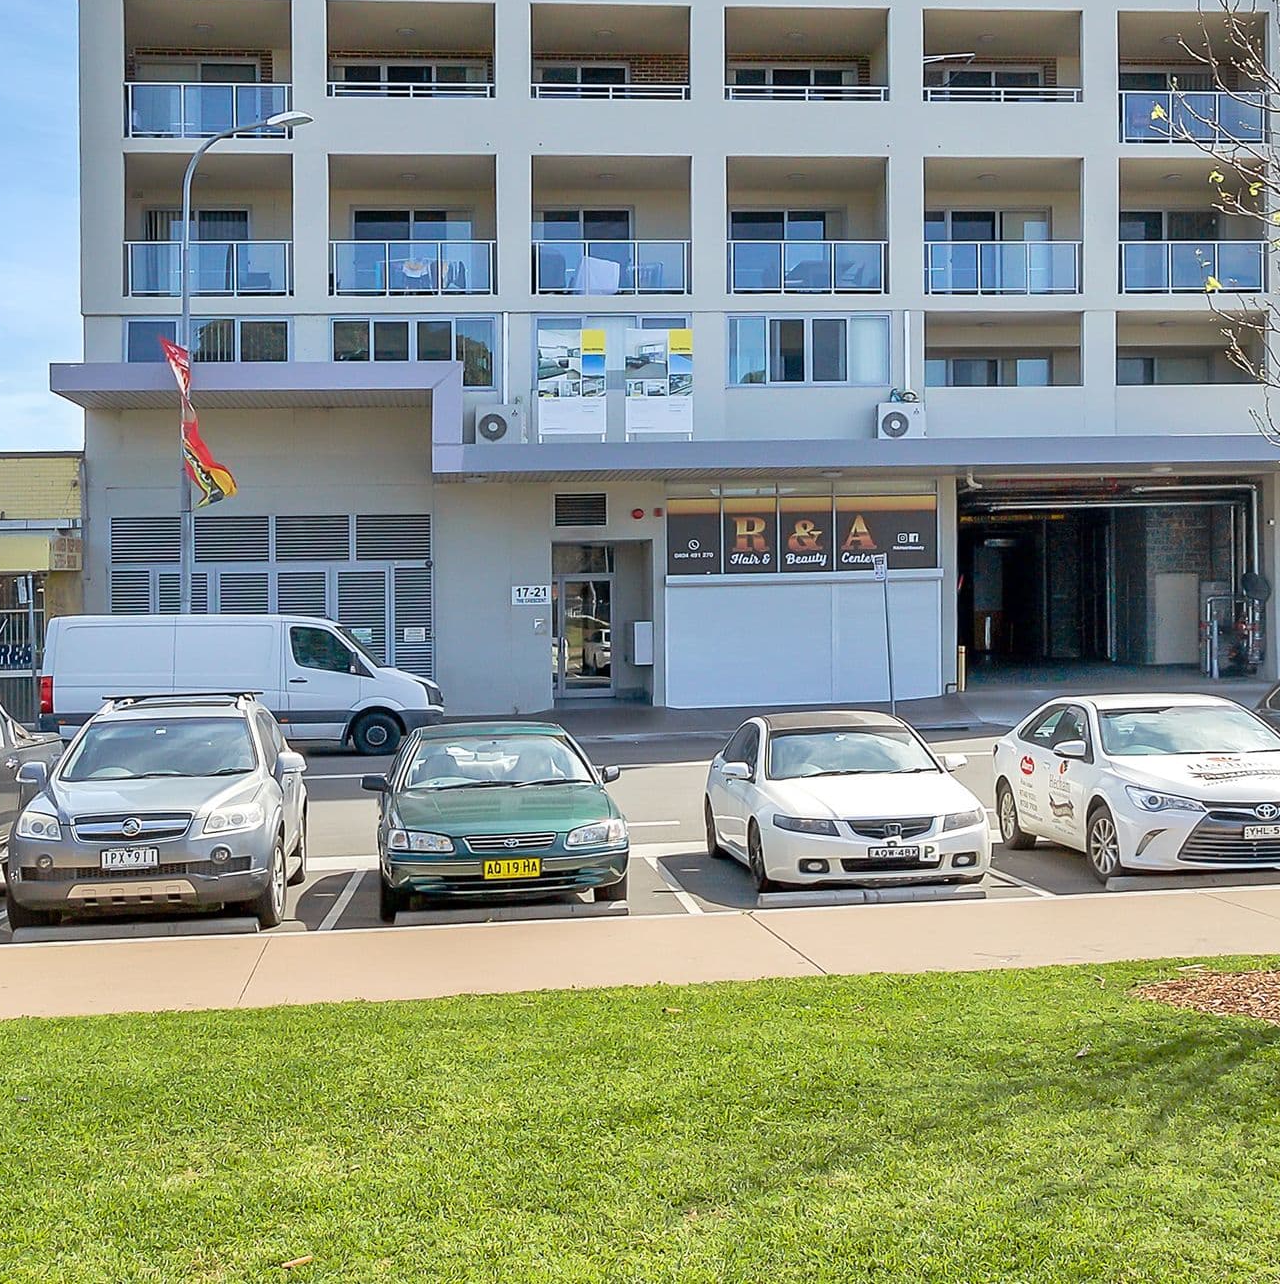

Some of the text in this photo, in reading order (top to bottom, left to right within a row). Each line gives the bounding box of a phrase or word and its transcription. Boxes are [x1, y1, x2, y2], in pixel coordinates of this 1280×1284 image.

[732, 515, 878, 552] R & A
[730, 552, 760, 566] Hair
[761, 553, 771, 564] &
[785, 552, 827, 567] Beauty
[516, 587, 547, 598] 17-21
[924, 845, 935, 858] P
[506, 862, 520, 873] 19
[523, 860, 537, 873] HA
